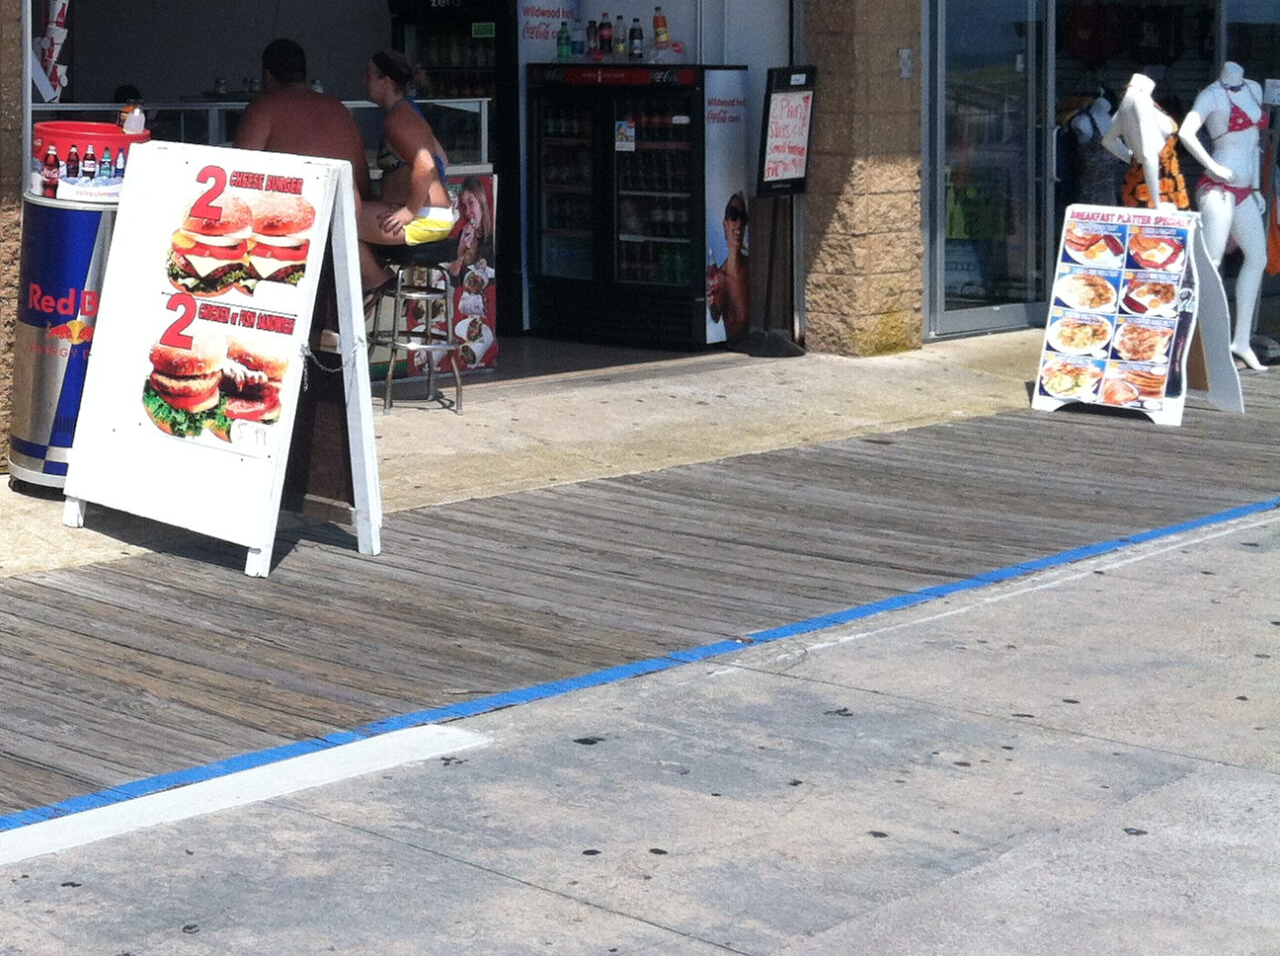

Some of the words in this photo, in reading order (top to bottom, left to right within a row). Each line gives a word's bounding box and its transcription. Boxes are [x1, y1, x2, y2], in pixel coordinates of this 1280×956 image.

[522, 5, 560, 18] Wildwood
[189, 165, 227, 221] 2
[230, 171, 265, 191] CHEESE
[265, 175, 304, 195] BURGER
[1070, 210, 1116, 222] BREAKFAST
[1117, 213, 1151, 225] PLATTER
[29, 283, 76, 315] Red
[159, 292, 198, 350] 2
